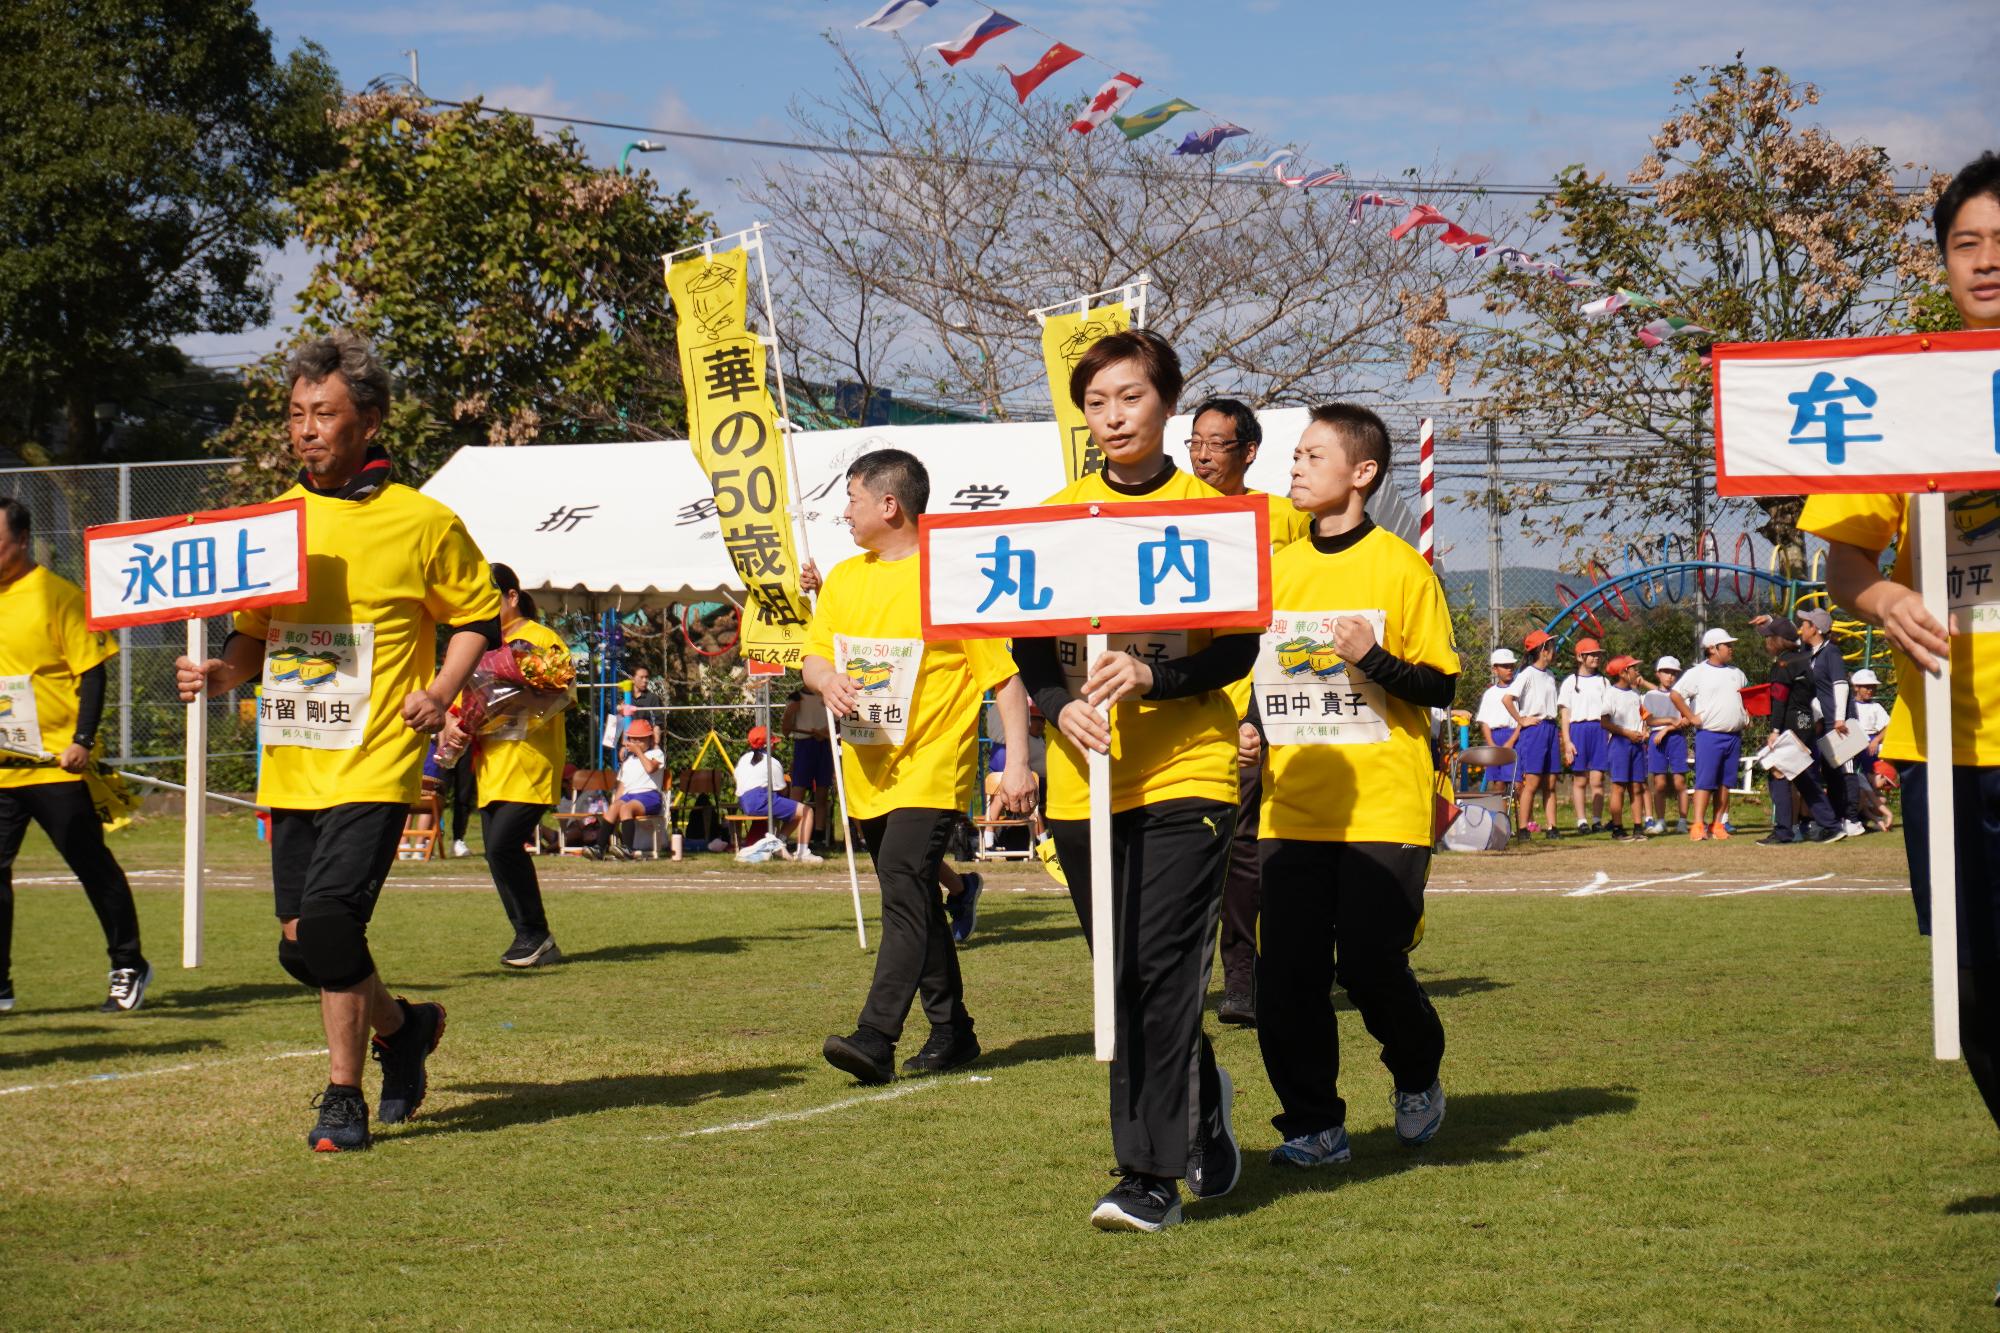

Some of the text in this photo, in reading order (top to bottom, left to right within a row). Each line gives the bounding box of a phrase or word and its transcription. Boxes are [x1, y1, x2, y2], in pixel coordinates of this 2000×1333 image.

[703, 345, 807, 626] 華の50歳組
[121, 528, 272, 605] 永田上
[975, 525, 1211, 613] 丸内
[1059, 640, 1087, 666] 田
[306, 699, 351, 724] 剛史
[868, 703, 902, 724] 竜也
[1266, 691, 1367, 717] 田中 貴子
